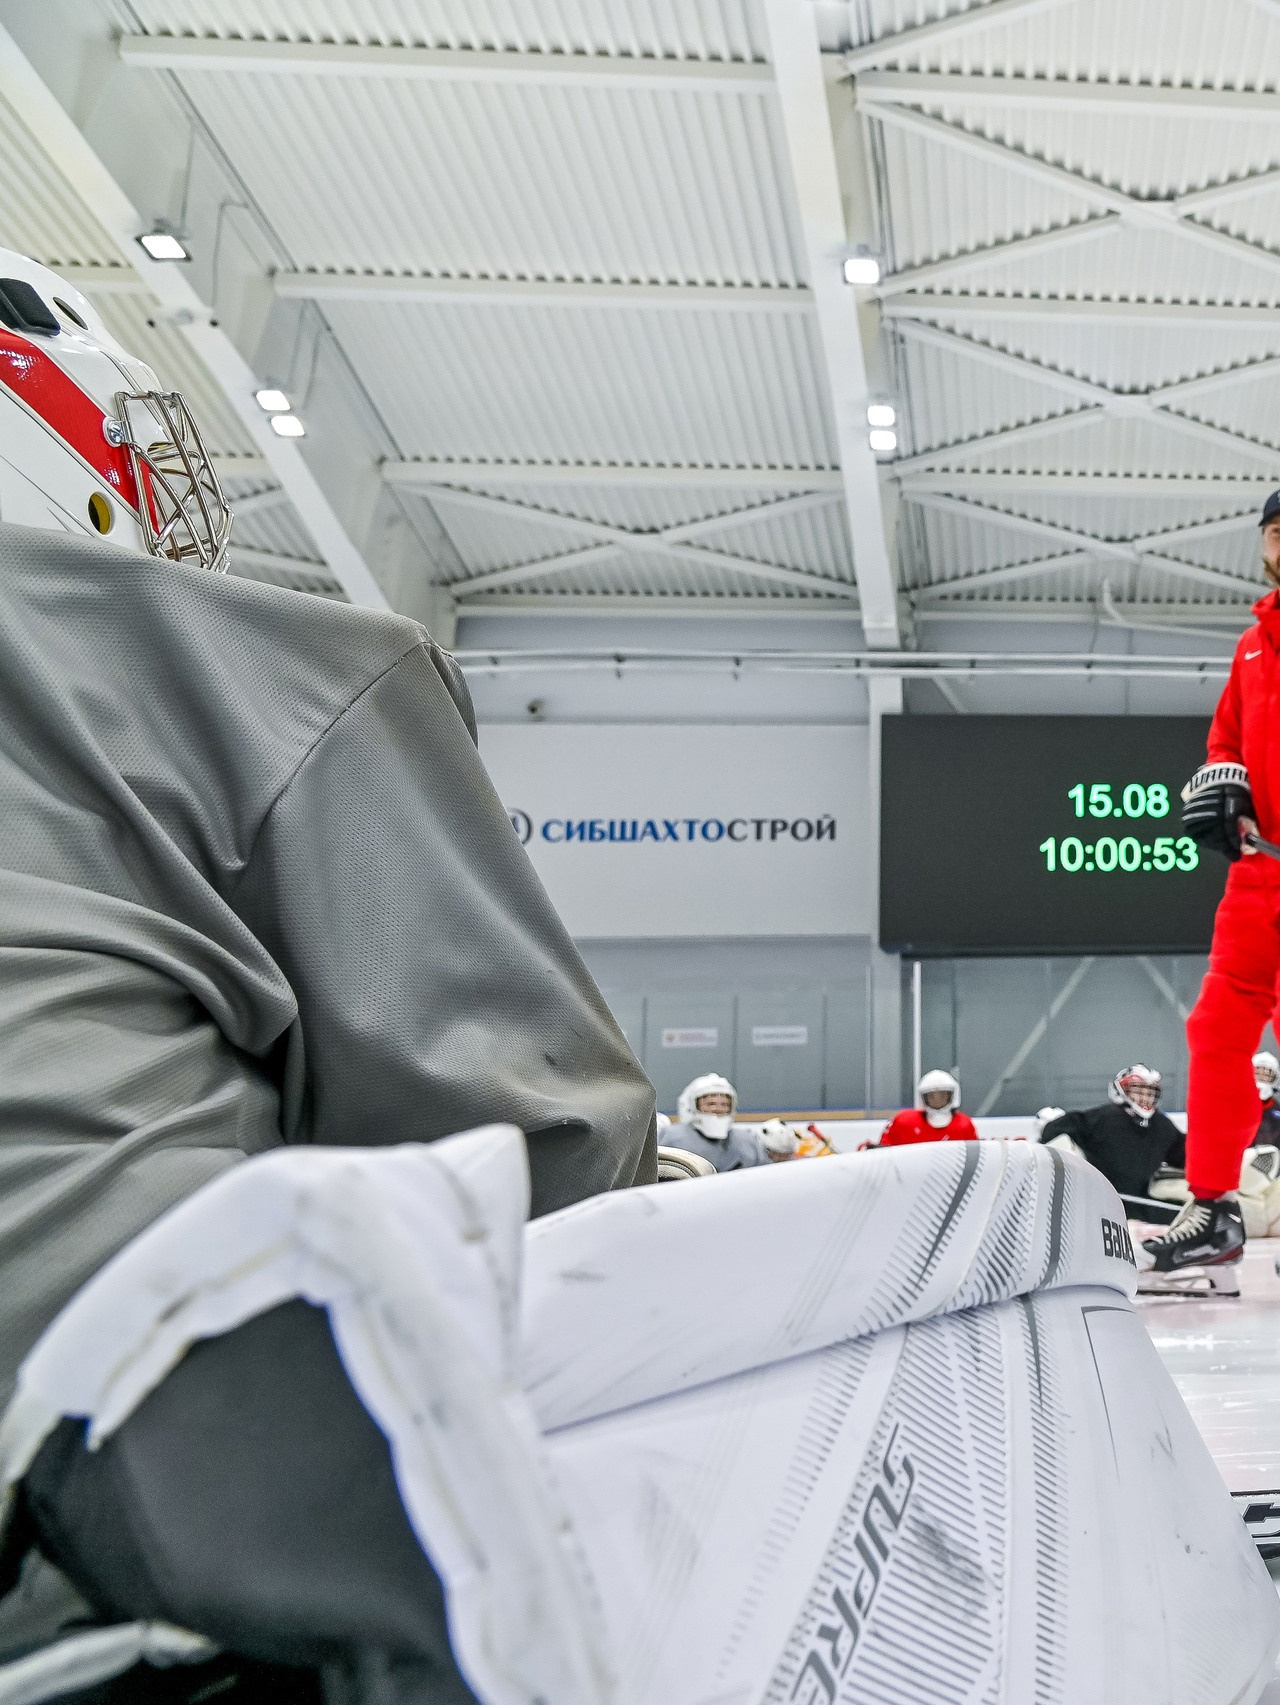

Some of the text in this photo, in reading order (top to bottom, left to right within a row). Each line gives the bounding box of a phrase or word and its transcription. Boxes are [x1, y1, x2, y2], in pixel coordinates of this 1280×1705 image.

[1068, 783, 1170, 818] 15.08
[541, 813, 836, 843] СИБШАХТОСТРОЙ
[1039, 836, 1199, 872] 10:00:53
